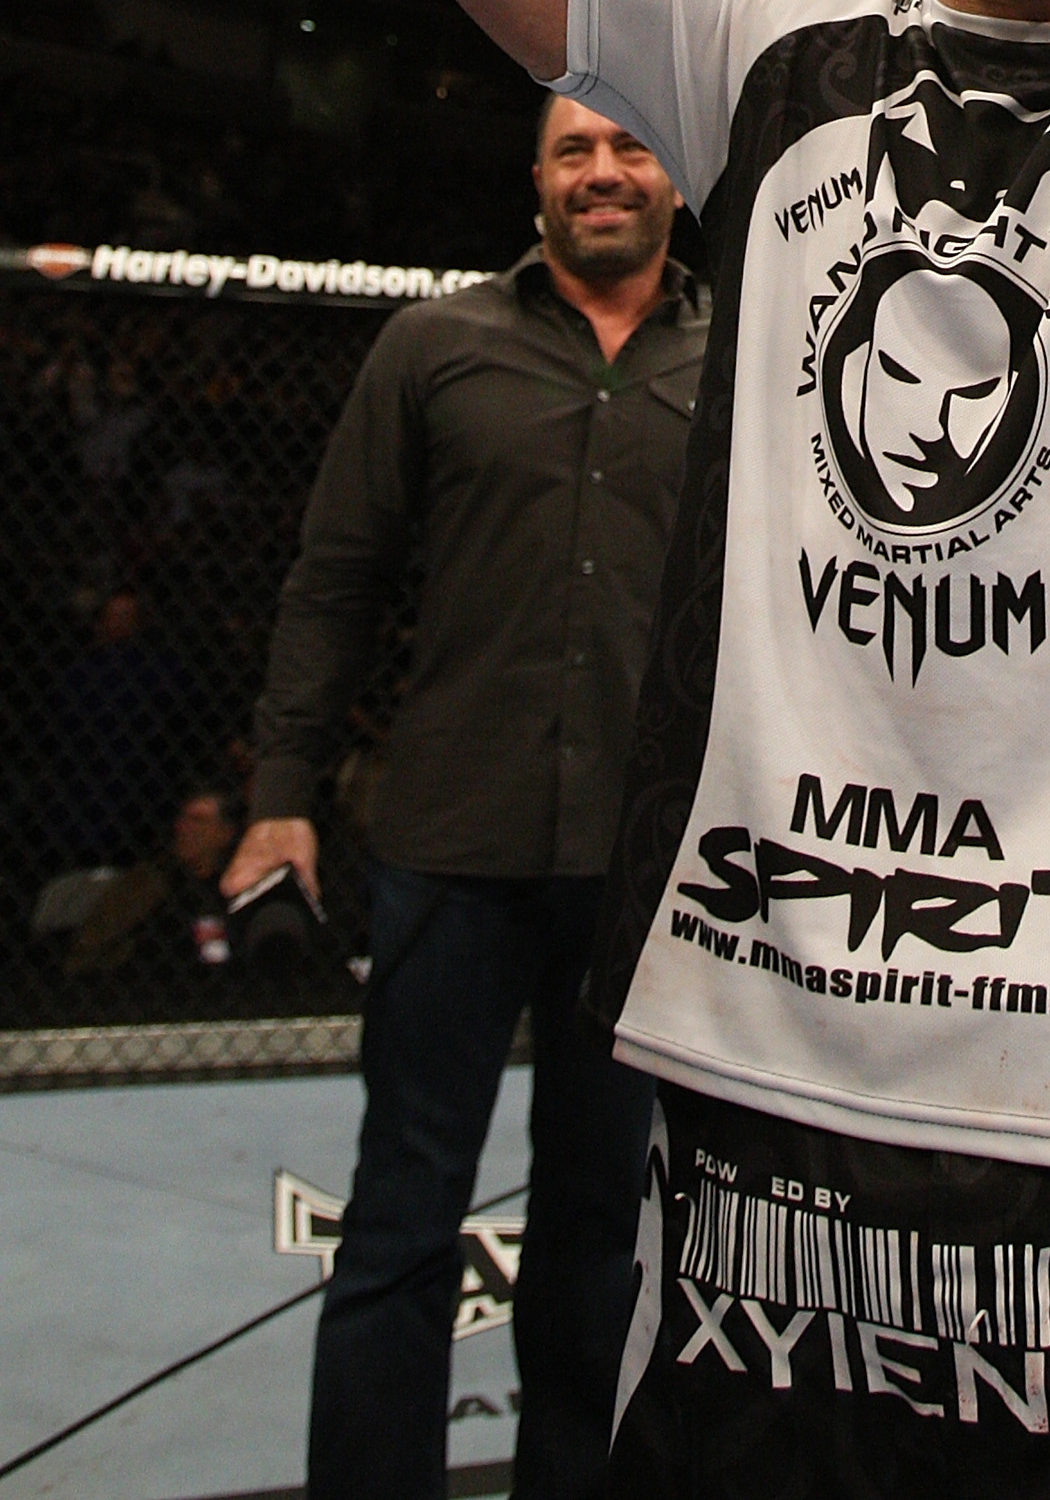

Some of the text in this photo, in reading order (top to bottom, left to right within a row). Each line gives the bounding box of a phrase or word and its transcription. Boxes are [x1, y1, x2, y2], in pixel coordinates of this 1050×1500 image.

[774, 167, 863, 242] VENUM
[92, 244, 497, 299] Harley-Davidson.co
[811, 432, 856, 530] MIXED
[856, 526, 990, 565] MARTIAL
[798, 546, 1047, 689] VENUM
[790, 772, 1005, 861] MMA
[695, 1148, 852, 1214] POWED BY
